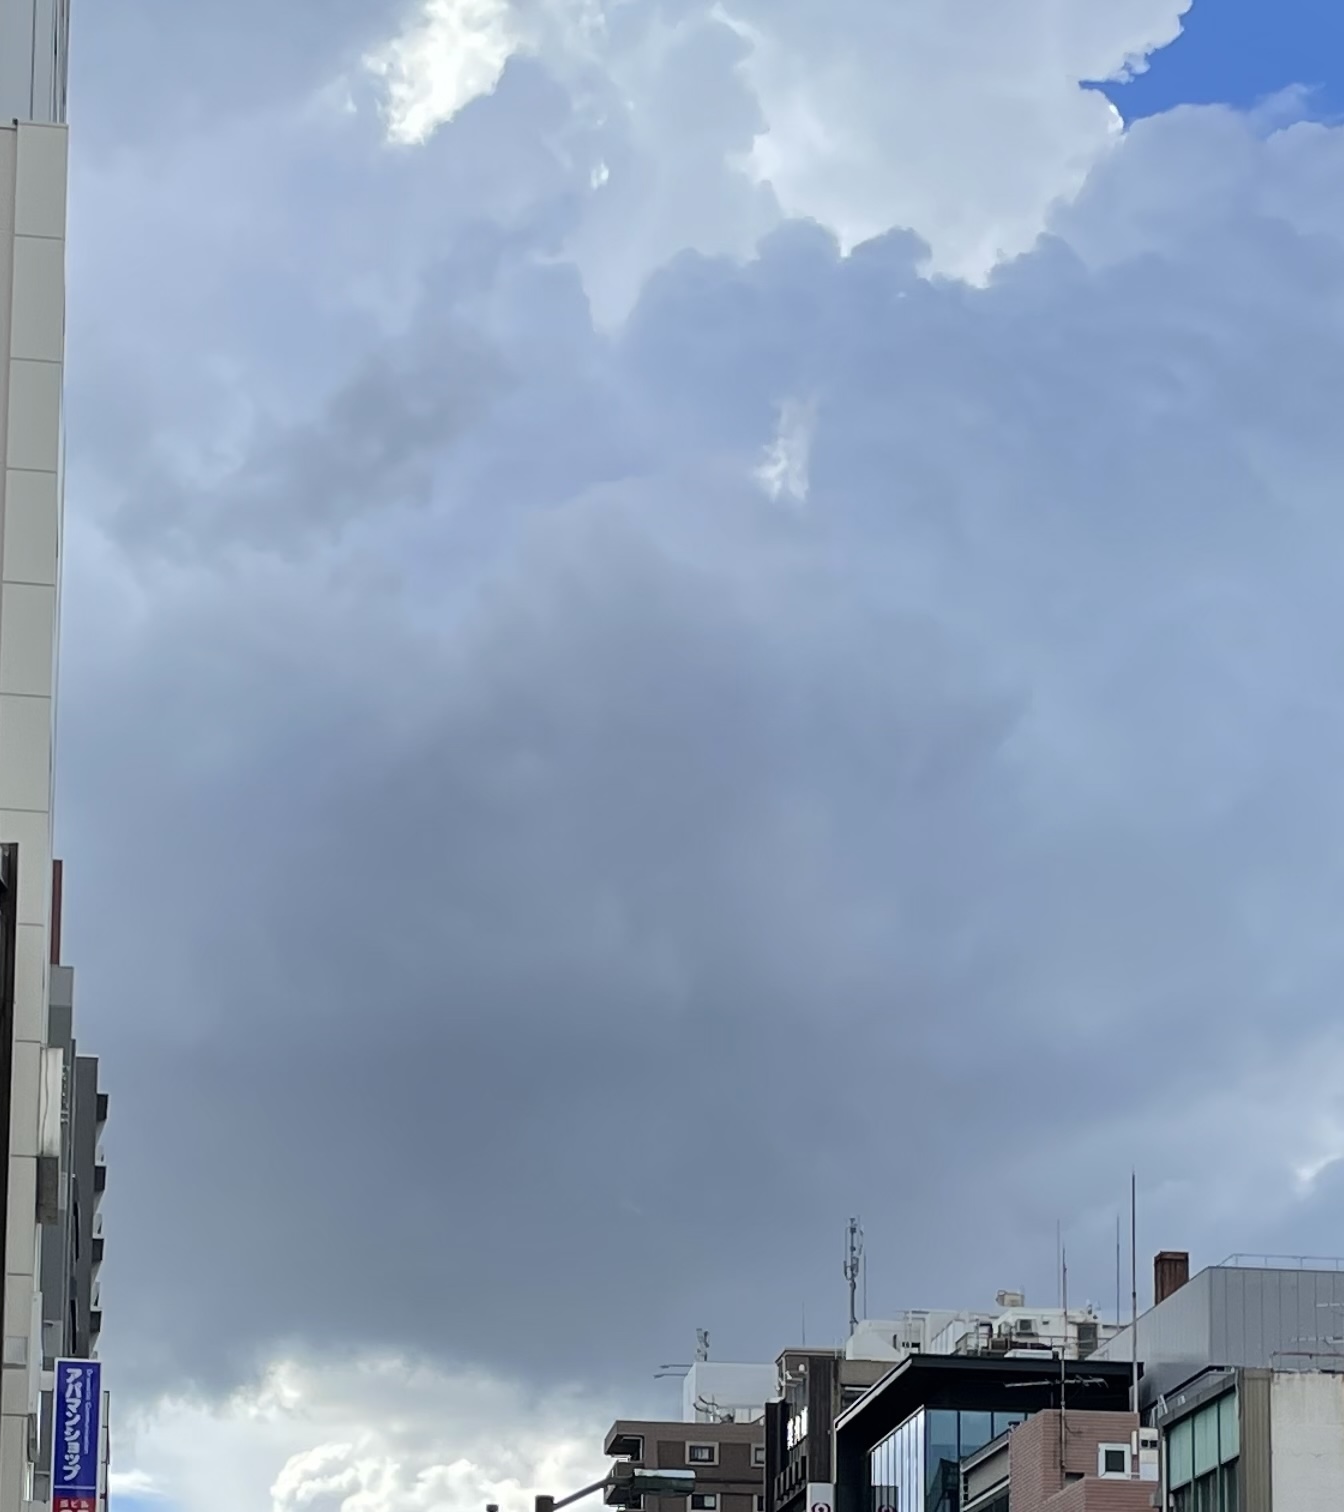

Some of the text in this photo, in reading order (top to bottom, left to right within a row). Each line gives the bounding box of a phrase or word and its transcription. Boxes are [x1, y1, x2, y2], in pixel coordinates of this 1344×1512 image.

[62, 1367, 83, 1481] アパマンショップ
